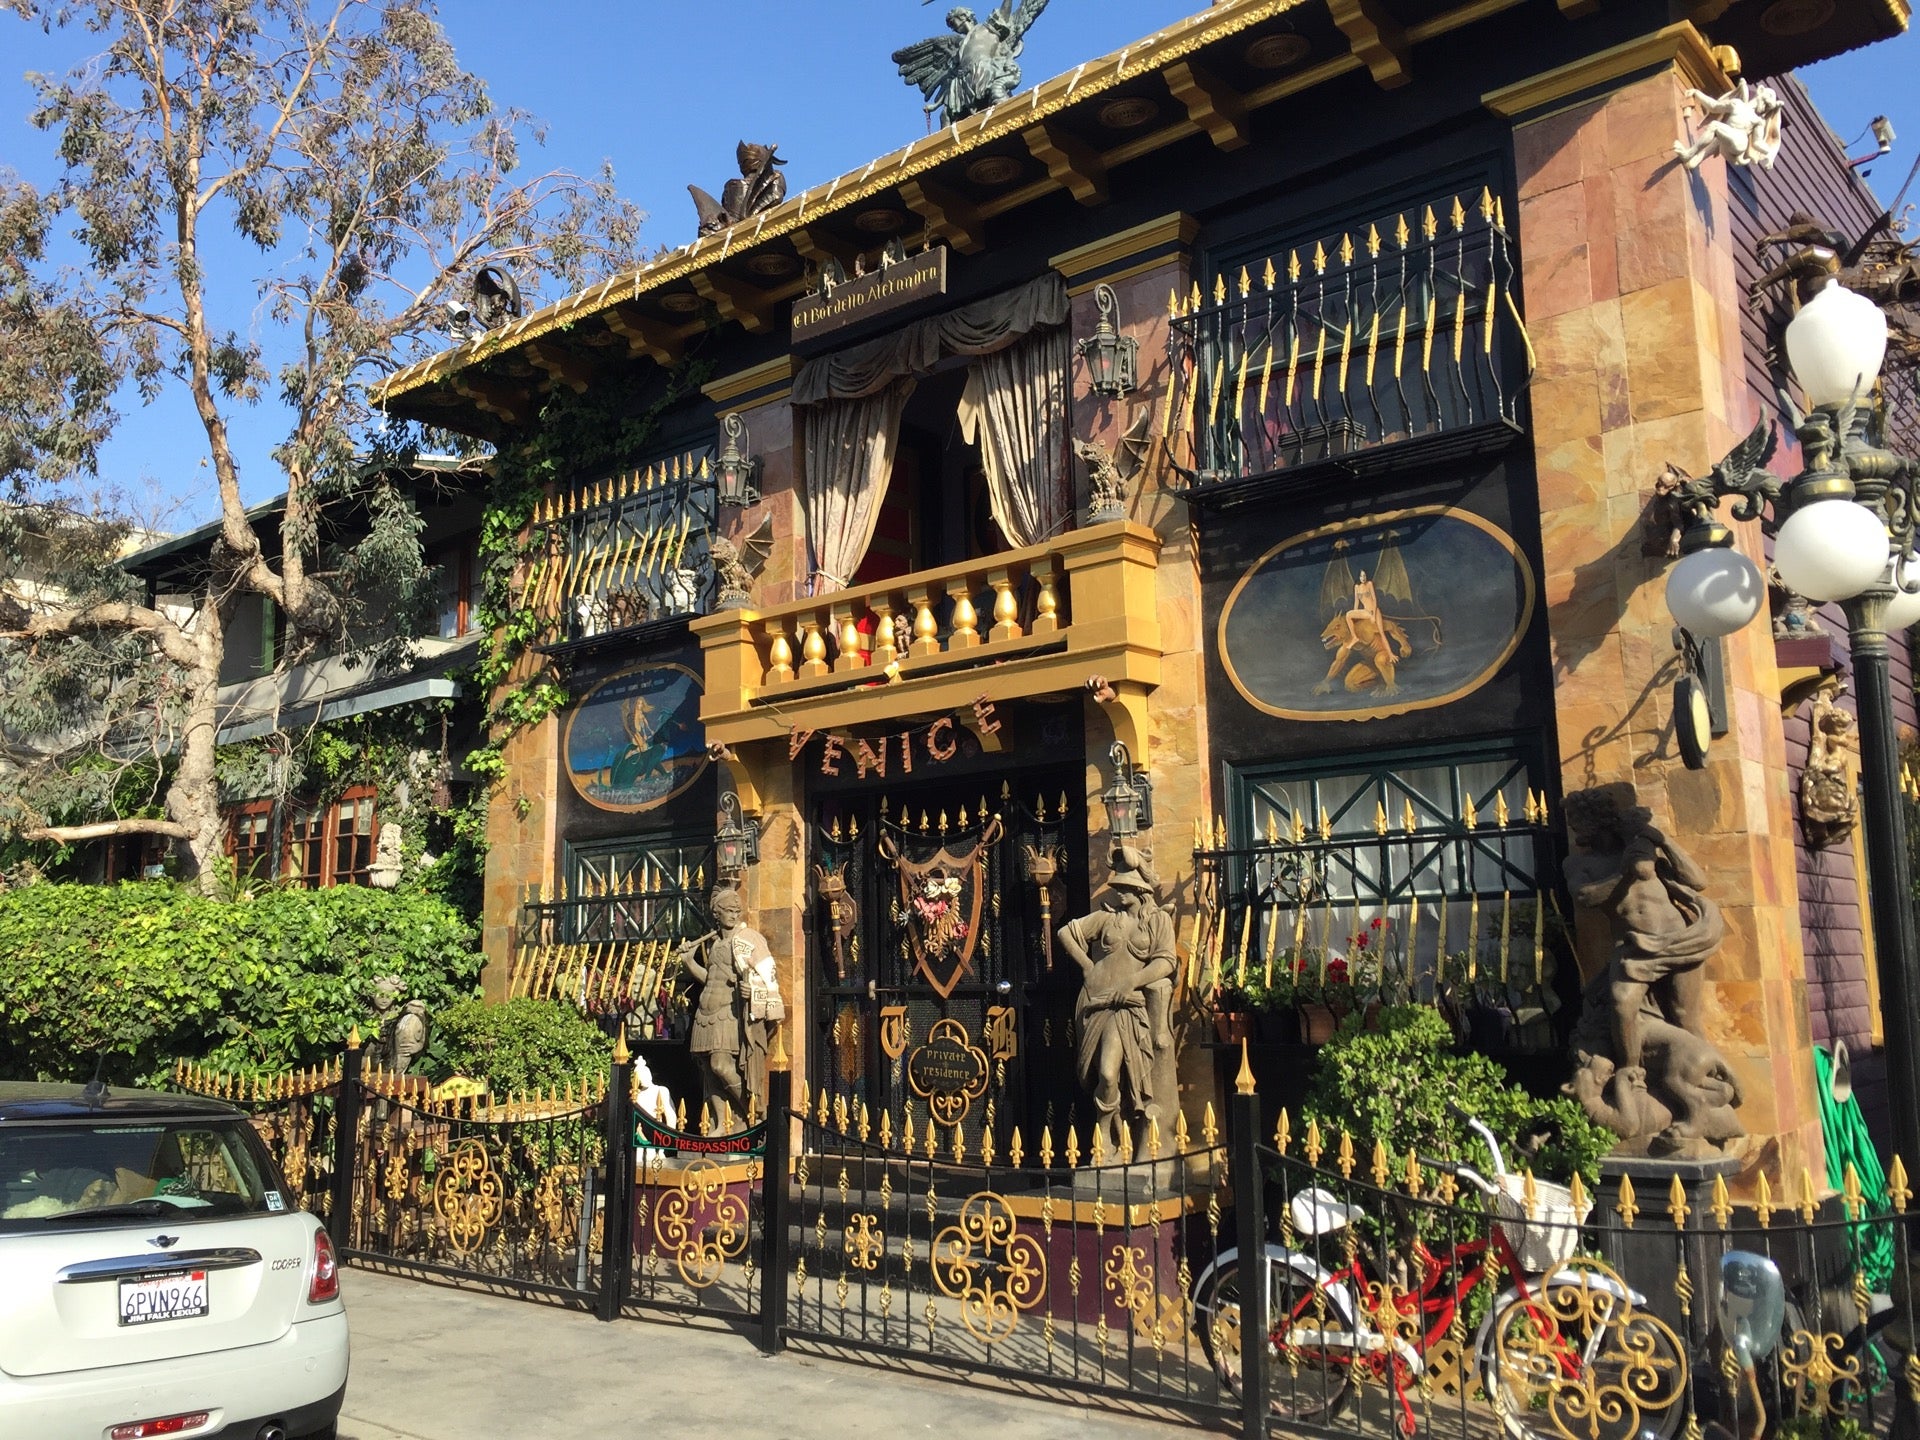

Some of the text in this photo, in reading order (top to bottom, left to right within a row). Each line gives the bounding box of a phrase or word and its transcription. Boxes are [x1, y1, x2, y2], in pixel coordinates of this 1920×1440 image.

[793, 266, 938, 329] El Bordello Alexandra
[788, 691, 1002, 780] VENICE
[923, 1066, 970, 1080] residence
[652, 1129, 751, 1153] NO TRESPASSING
[271, 1257, 302, 1271] COOPER
[125, 1285, 202, 1316] 6PVN966
[127, 1307, 201, 1323] JIM FALK LEXUS
